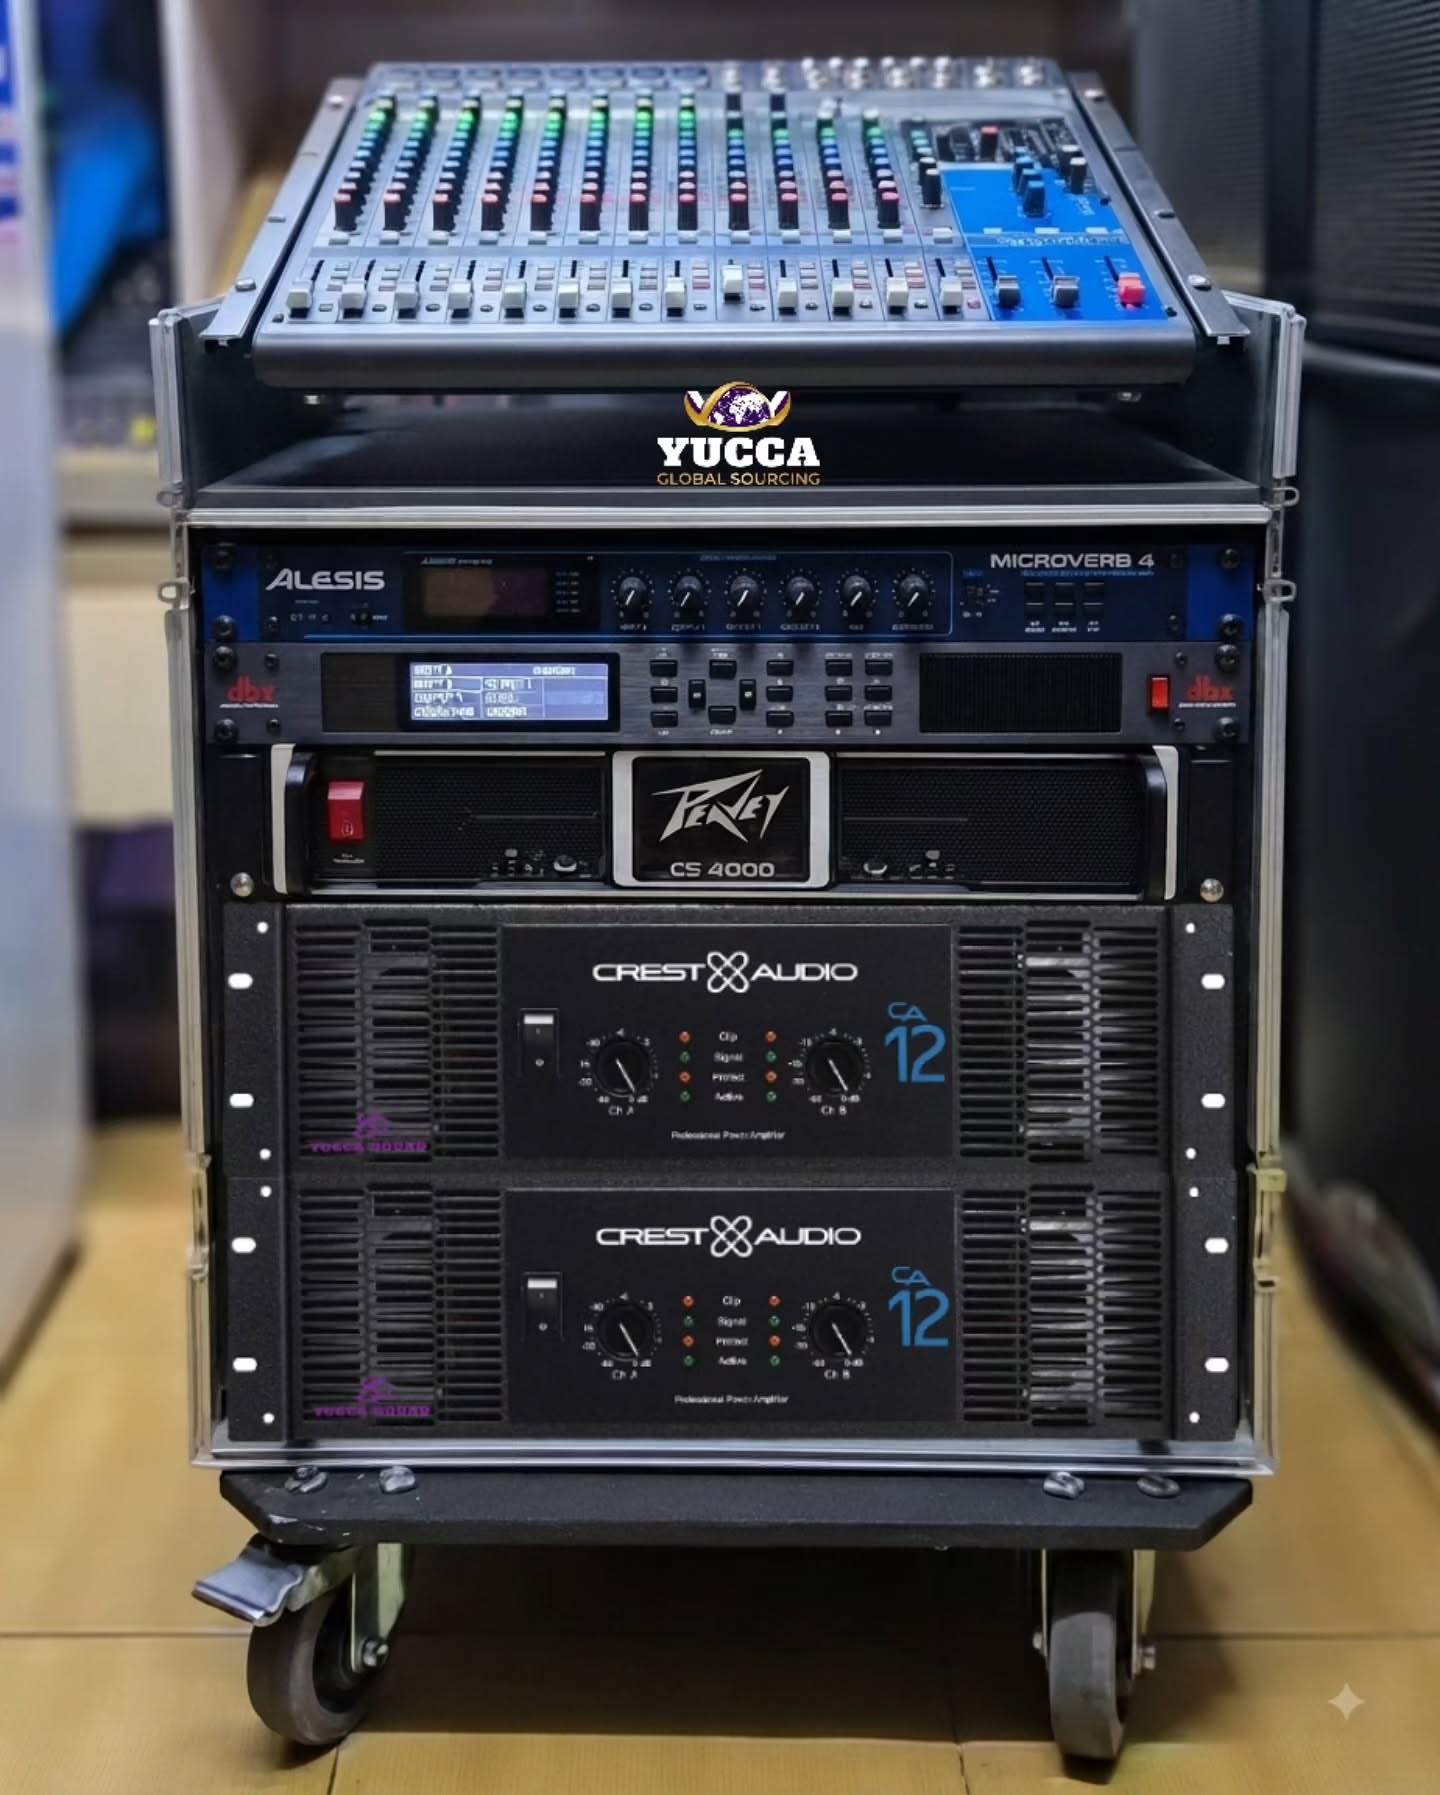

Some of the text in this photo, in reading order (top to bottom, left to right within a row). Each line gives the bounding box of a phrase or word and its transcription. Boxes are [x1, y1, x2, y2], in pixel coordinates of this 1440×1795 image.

[990, 554, 1155, 569] MICROVERB 4
[265, 568, 386, 591] ALESIS
[670, 862, 775, 877] CS 4000
[592, 963, 858, 981] CREST AUDIO
[887, 1002, 928, 1021] CA
[884, 1024, 946, 1083] 12
[596, 1227, 862, 1245] CREST AUDIO
[891, 1266, 932, 1286] CA
[888, 1288, 949, 1347] 12
